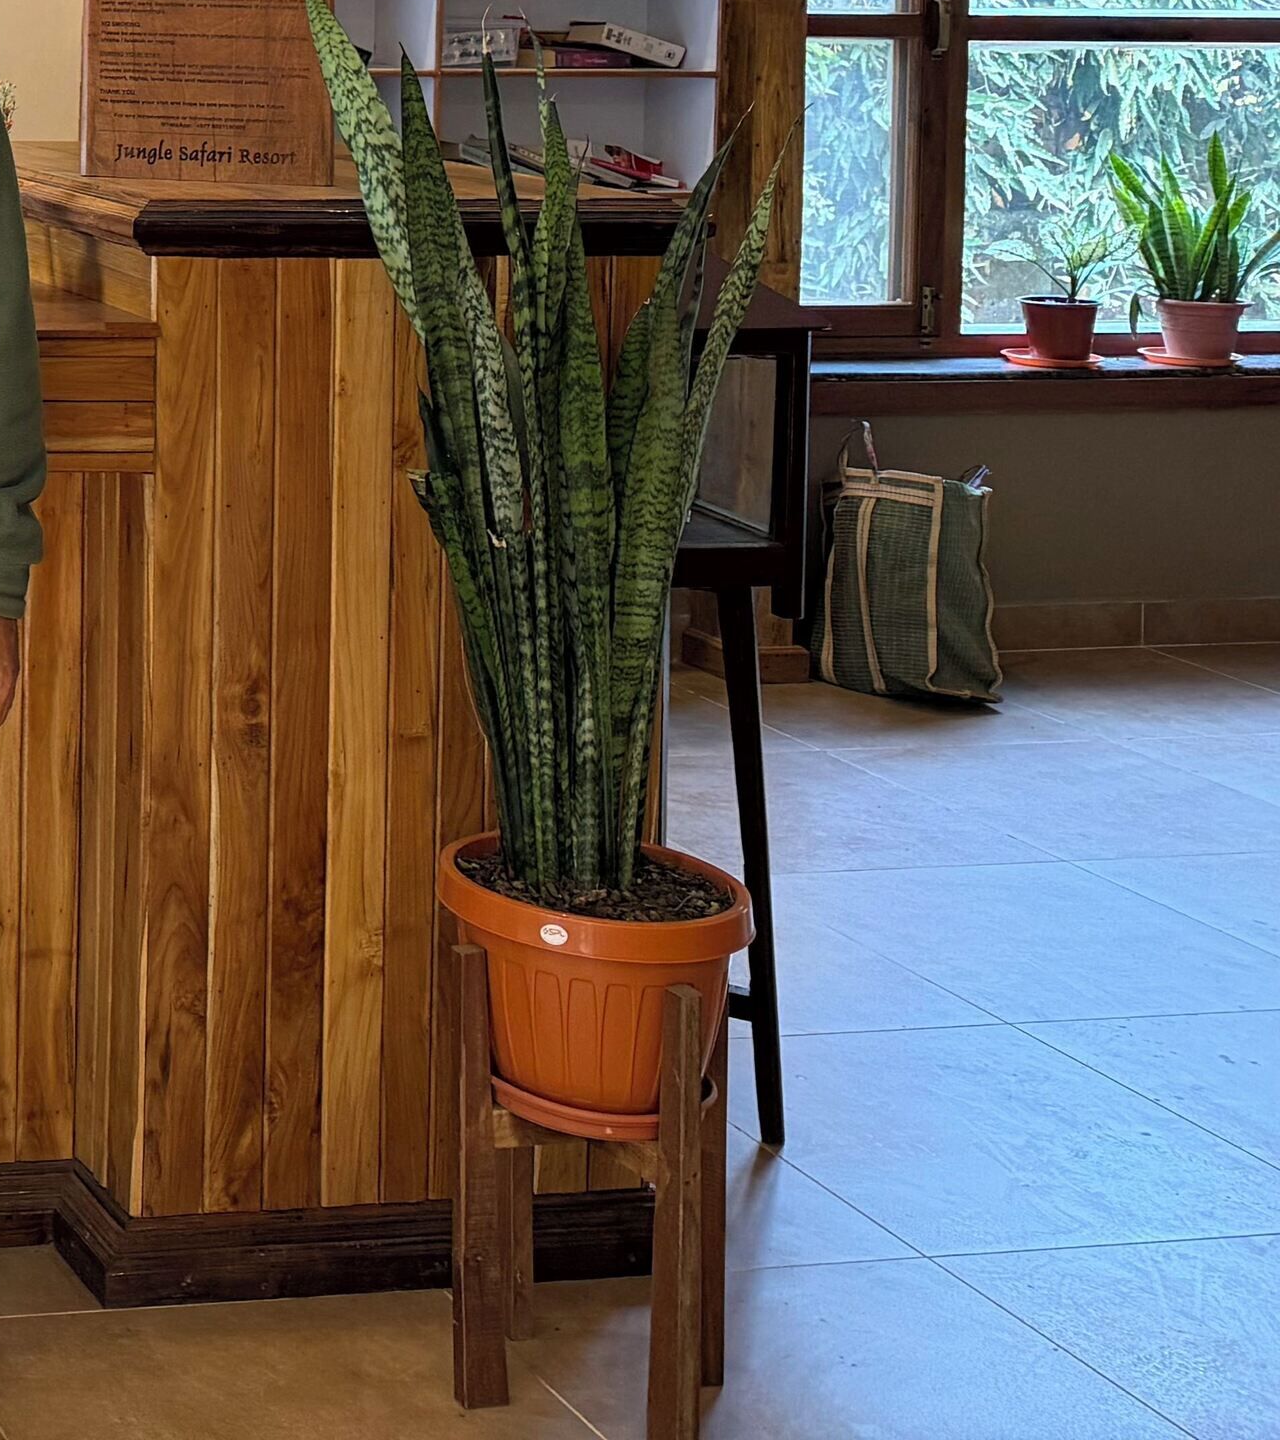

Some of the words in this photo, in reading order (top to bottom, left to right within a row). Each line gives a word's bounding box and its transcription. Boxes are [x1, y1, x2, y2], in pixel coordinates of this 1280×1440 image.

[113, 138, 173, 165] Jungle
[179, 140, 233, 167] Safari
[238, 147, 297, 167] Resort
